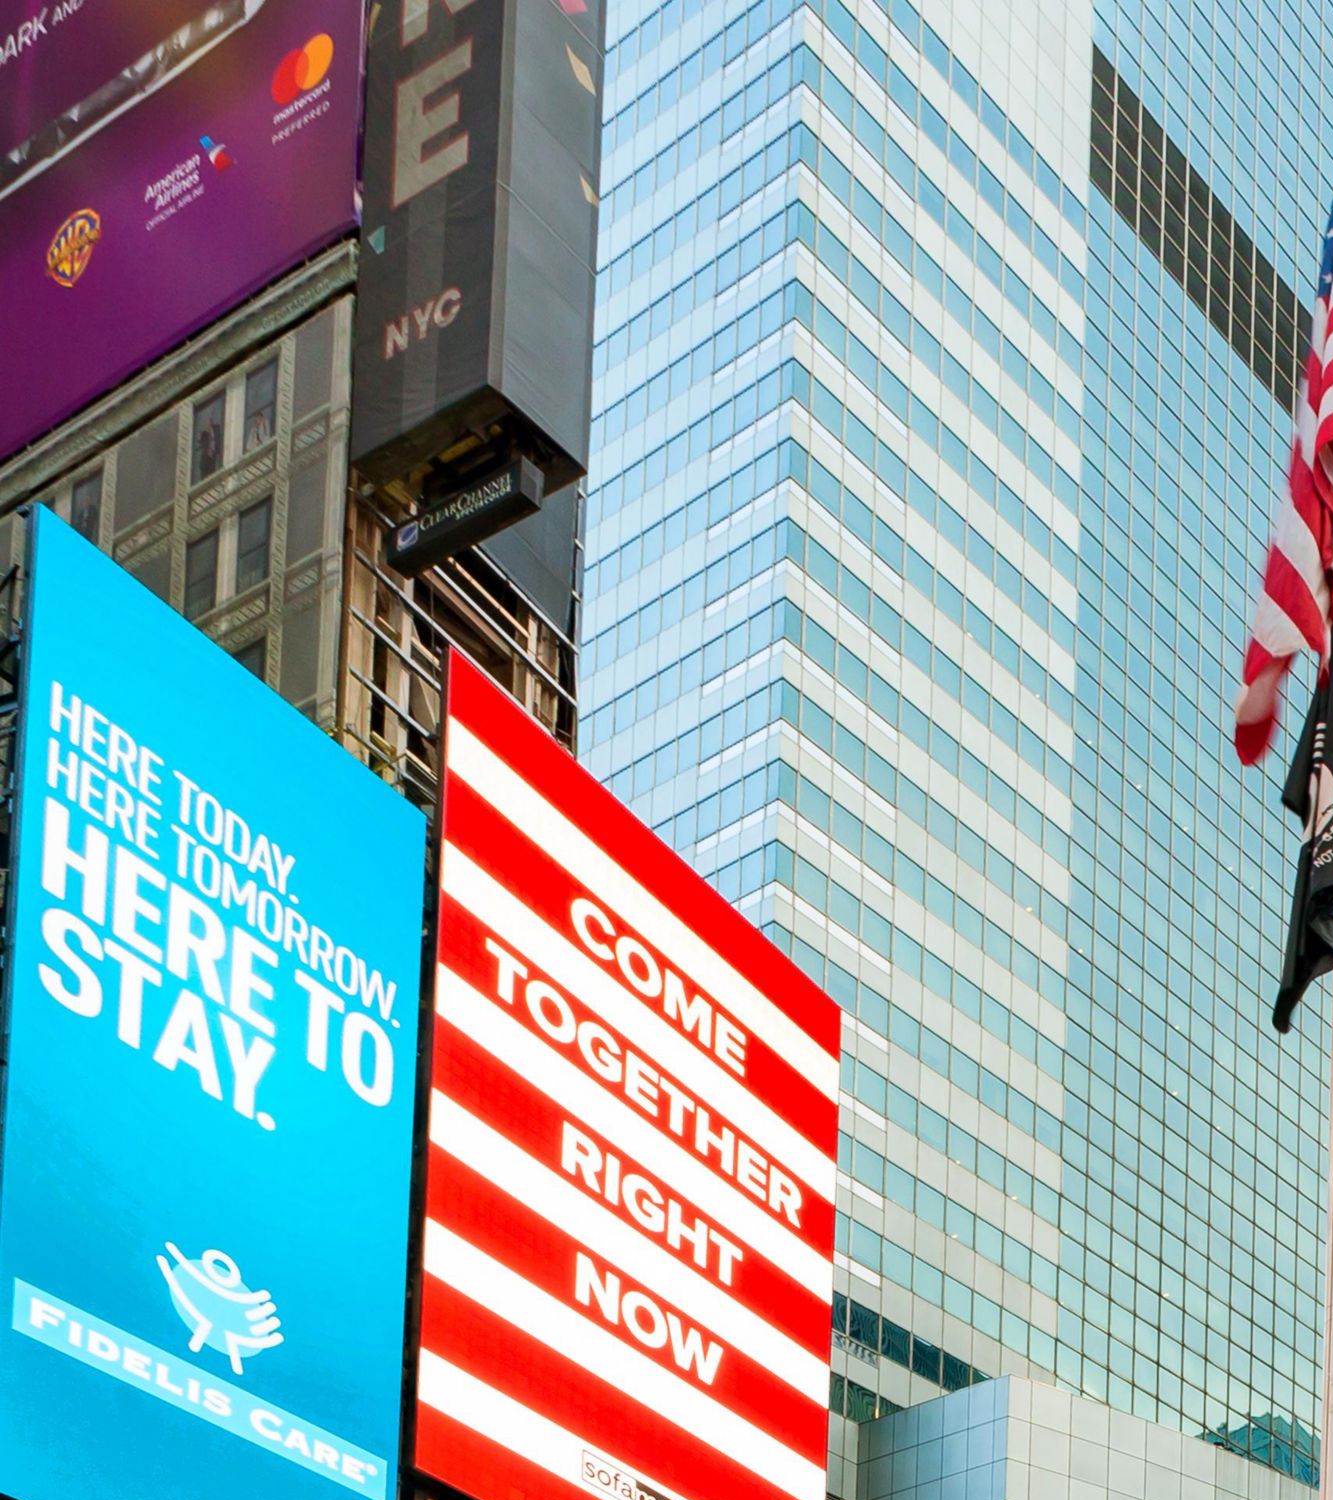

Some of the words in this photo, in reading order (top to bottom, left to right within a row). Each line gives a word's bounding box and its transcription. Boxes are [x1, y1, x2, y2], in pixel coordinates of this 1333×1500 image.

[271, 101, 331, 146] PREFERRED
[273, 79, 331, 125] mastercard
[144, 154, 201, 203] American
[154, 171, 200, 211] Airlines
[384, 287, 462, 360] NYC
[50, 680, 164, 805] HERE
[173, 770, 299, 904] TODAY.
[41, 796, 278, 1038] HERE
[295, 969, 394, 1107] TO
[47, 737, 162, 860] HERE
[171, 823, 400, 1029] TOMORROW.
[38, 908, 276, 1131] STAY.
[570, 898, 747, 1077] COME
[485, 937, 802, 1229] TOGETHER
[561, 1120, 743, 1287] RIGHT
[29, 1297, 232, 1417] FIDELIS
[575, 1251, 724, 1386] NOW
